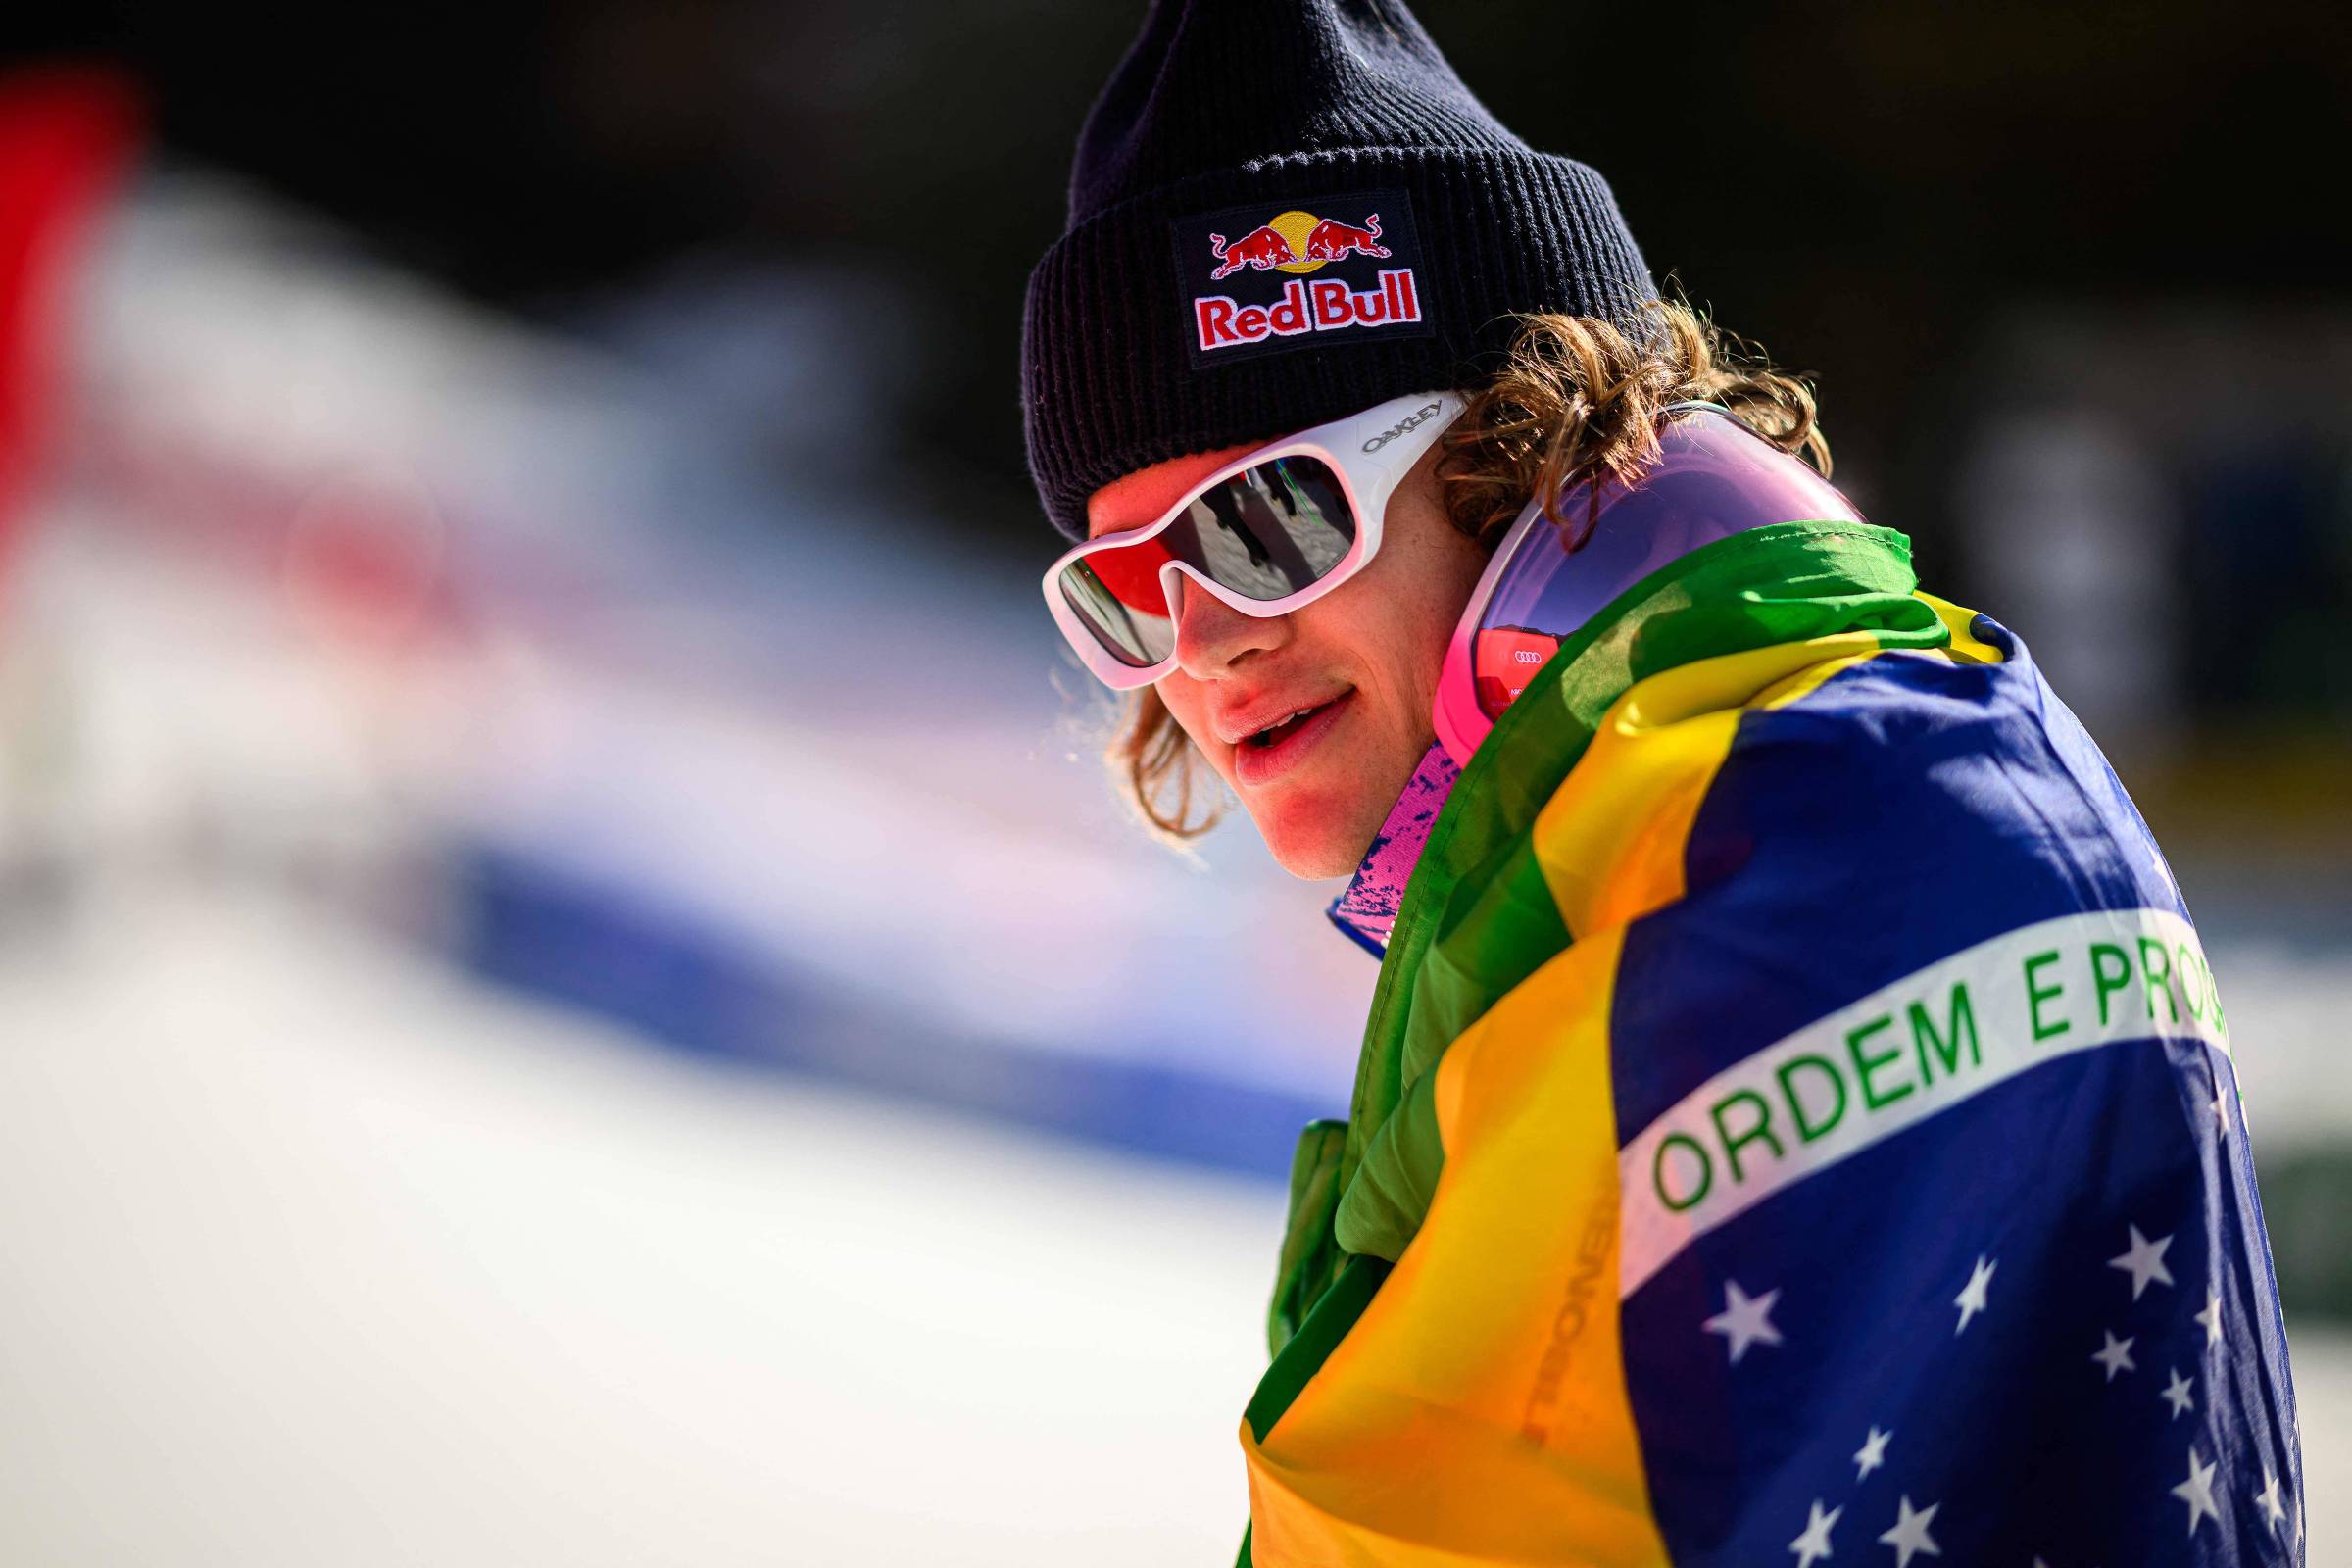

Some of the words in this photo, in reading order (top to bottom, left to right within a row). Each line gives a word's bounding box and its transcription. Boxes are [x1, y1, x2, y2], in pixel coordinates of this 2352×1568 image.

[1195, 278, 1312, 351] Red
[1309, 268, 1422, 331] Bull
[1361, 398, 1443, 455] OAKLEY
[1653, 980, 1983, 1212] ORDEM
[2022, 949, 2072, 1044] E
